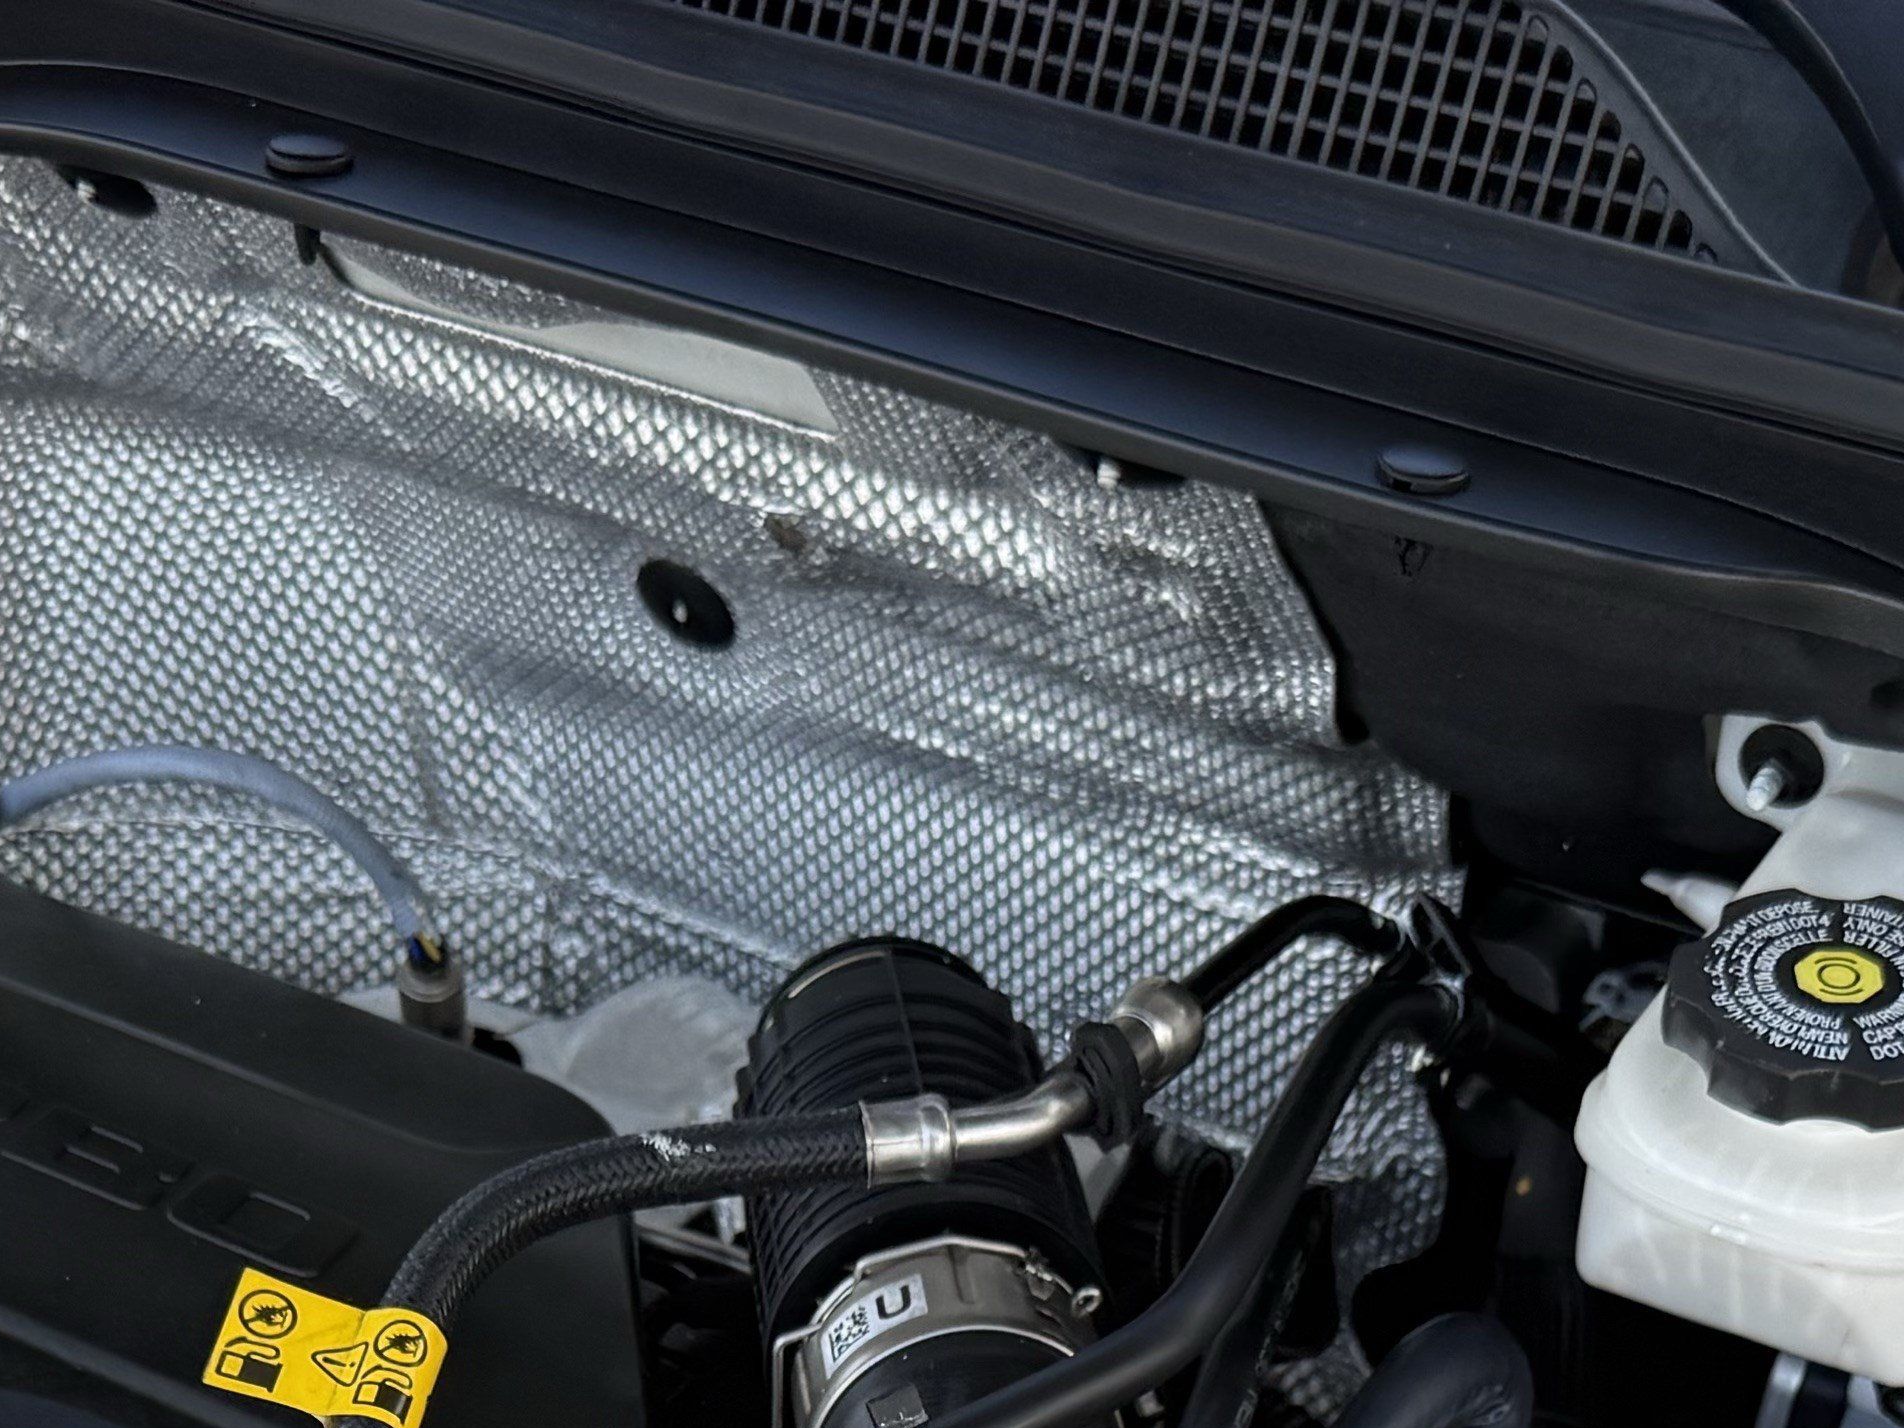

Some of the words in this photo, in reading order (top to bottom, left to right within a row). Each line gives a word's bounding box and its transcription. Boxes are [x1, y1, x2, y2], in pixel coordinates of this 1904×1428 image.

[1843, 916, 1890, 937] ONLY
[1842, 931, 1900, 958] FILLER
[1861, 1025, 1902, 1044] CAP
[875, 1284, 911, 1321] U
